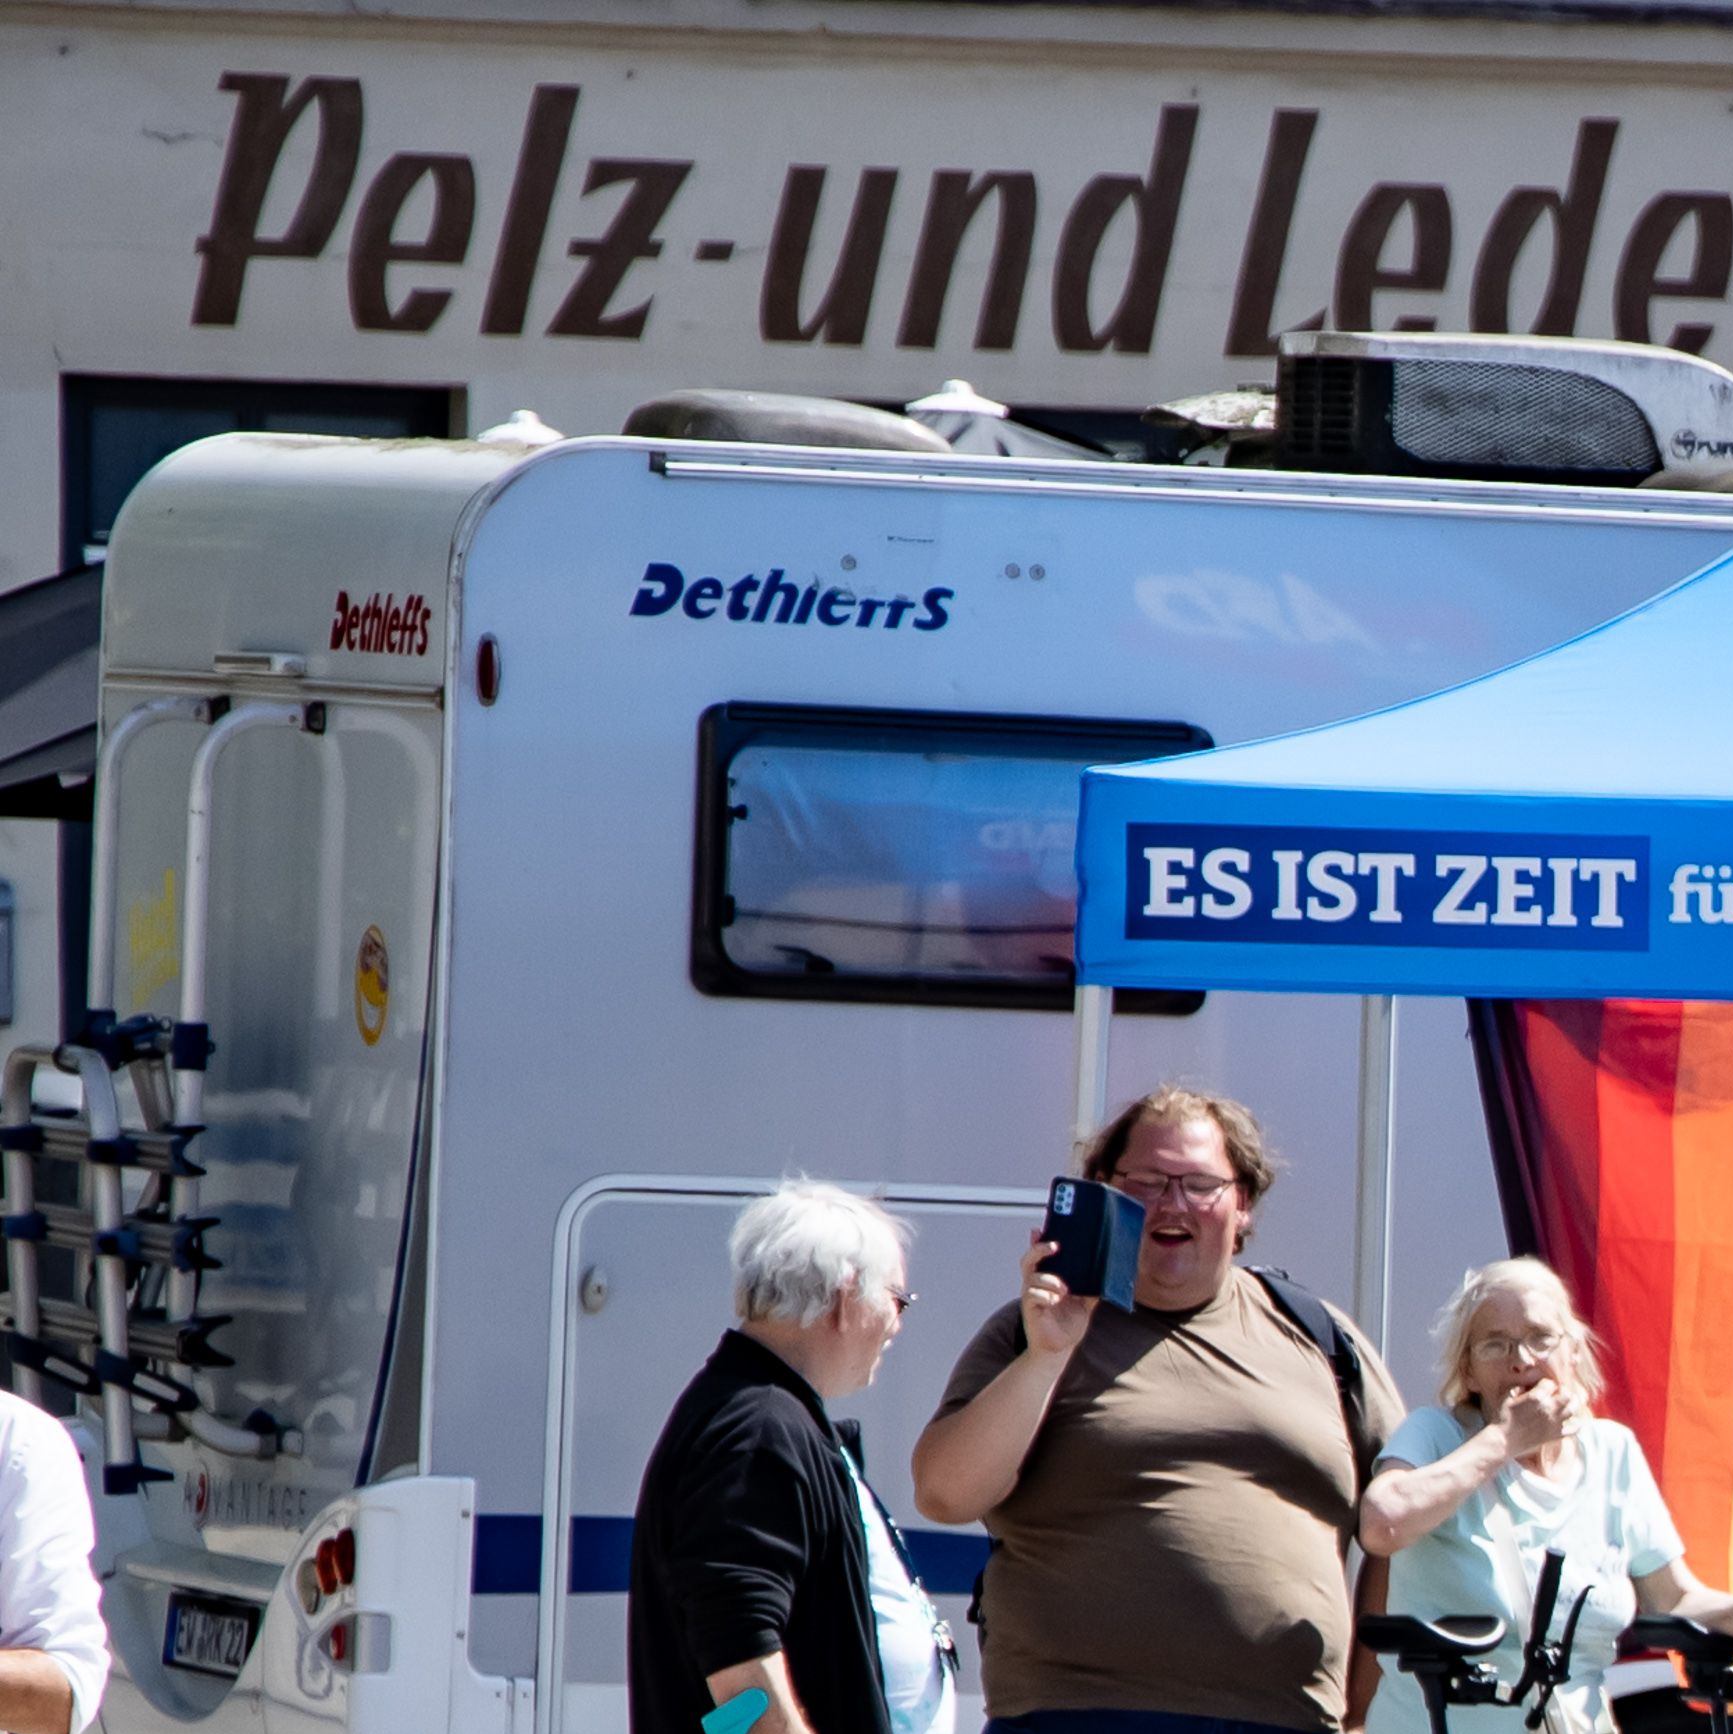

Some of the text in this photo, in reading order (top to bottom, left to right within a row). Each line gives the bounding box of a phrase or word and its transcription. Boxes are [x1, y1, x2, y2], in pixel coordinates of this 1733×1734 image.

[330, 590, 431, 656] Dethleffs
[1143, 847, 1252, 919] ES
[1271, 850, 1414, 922] IST
[1433, 855, 1636, 928] ZEIT
